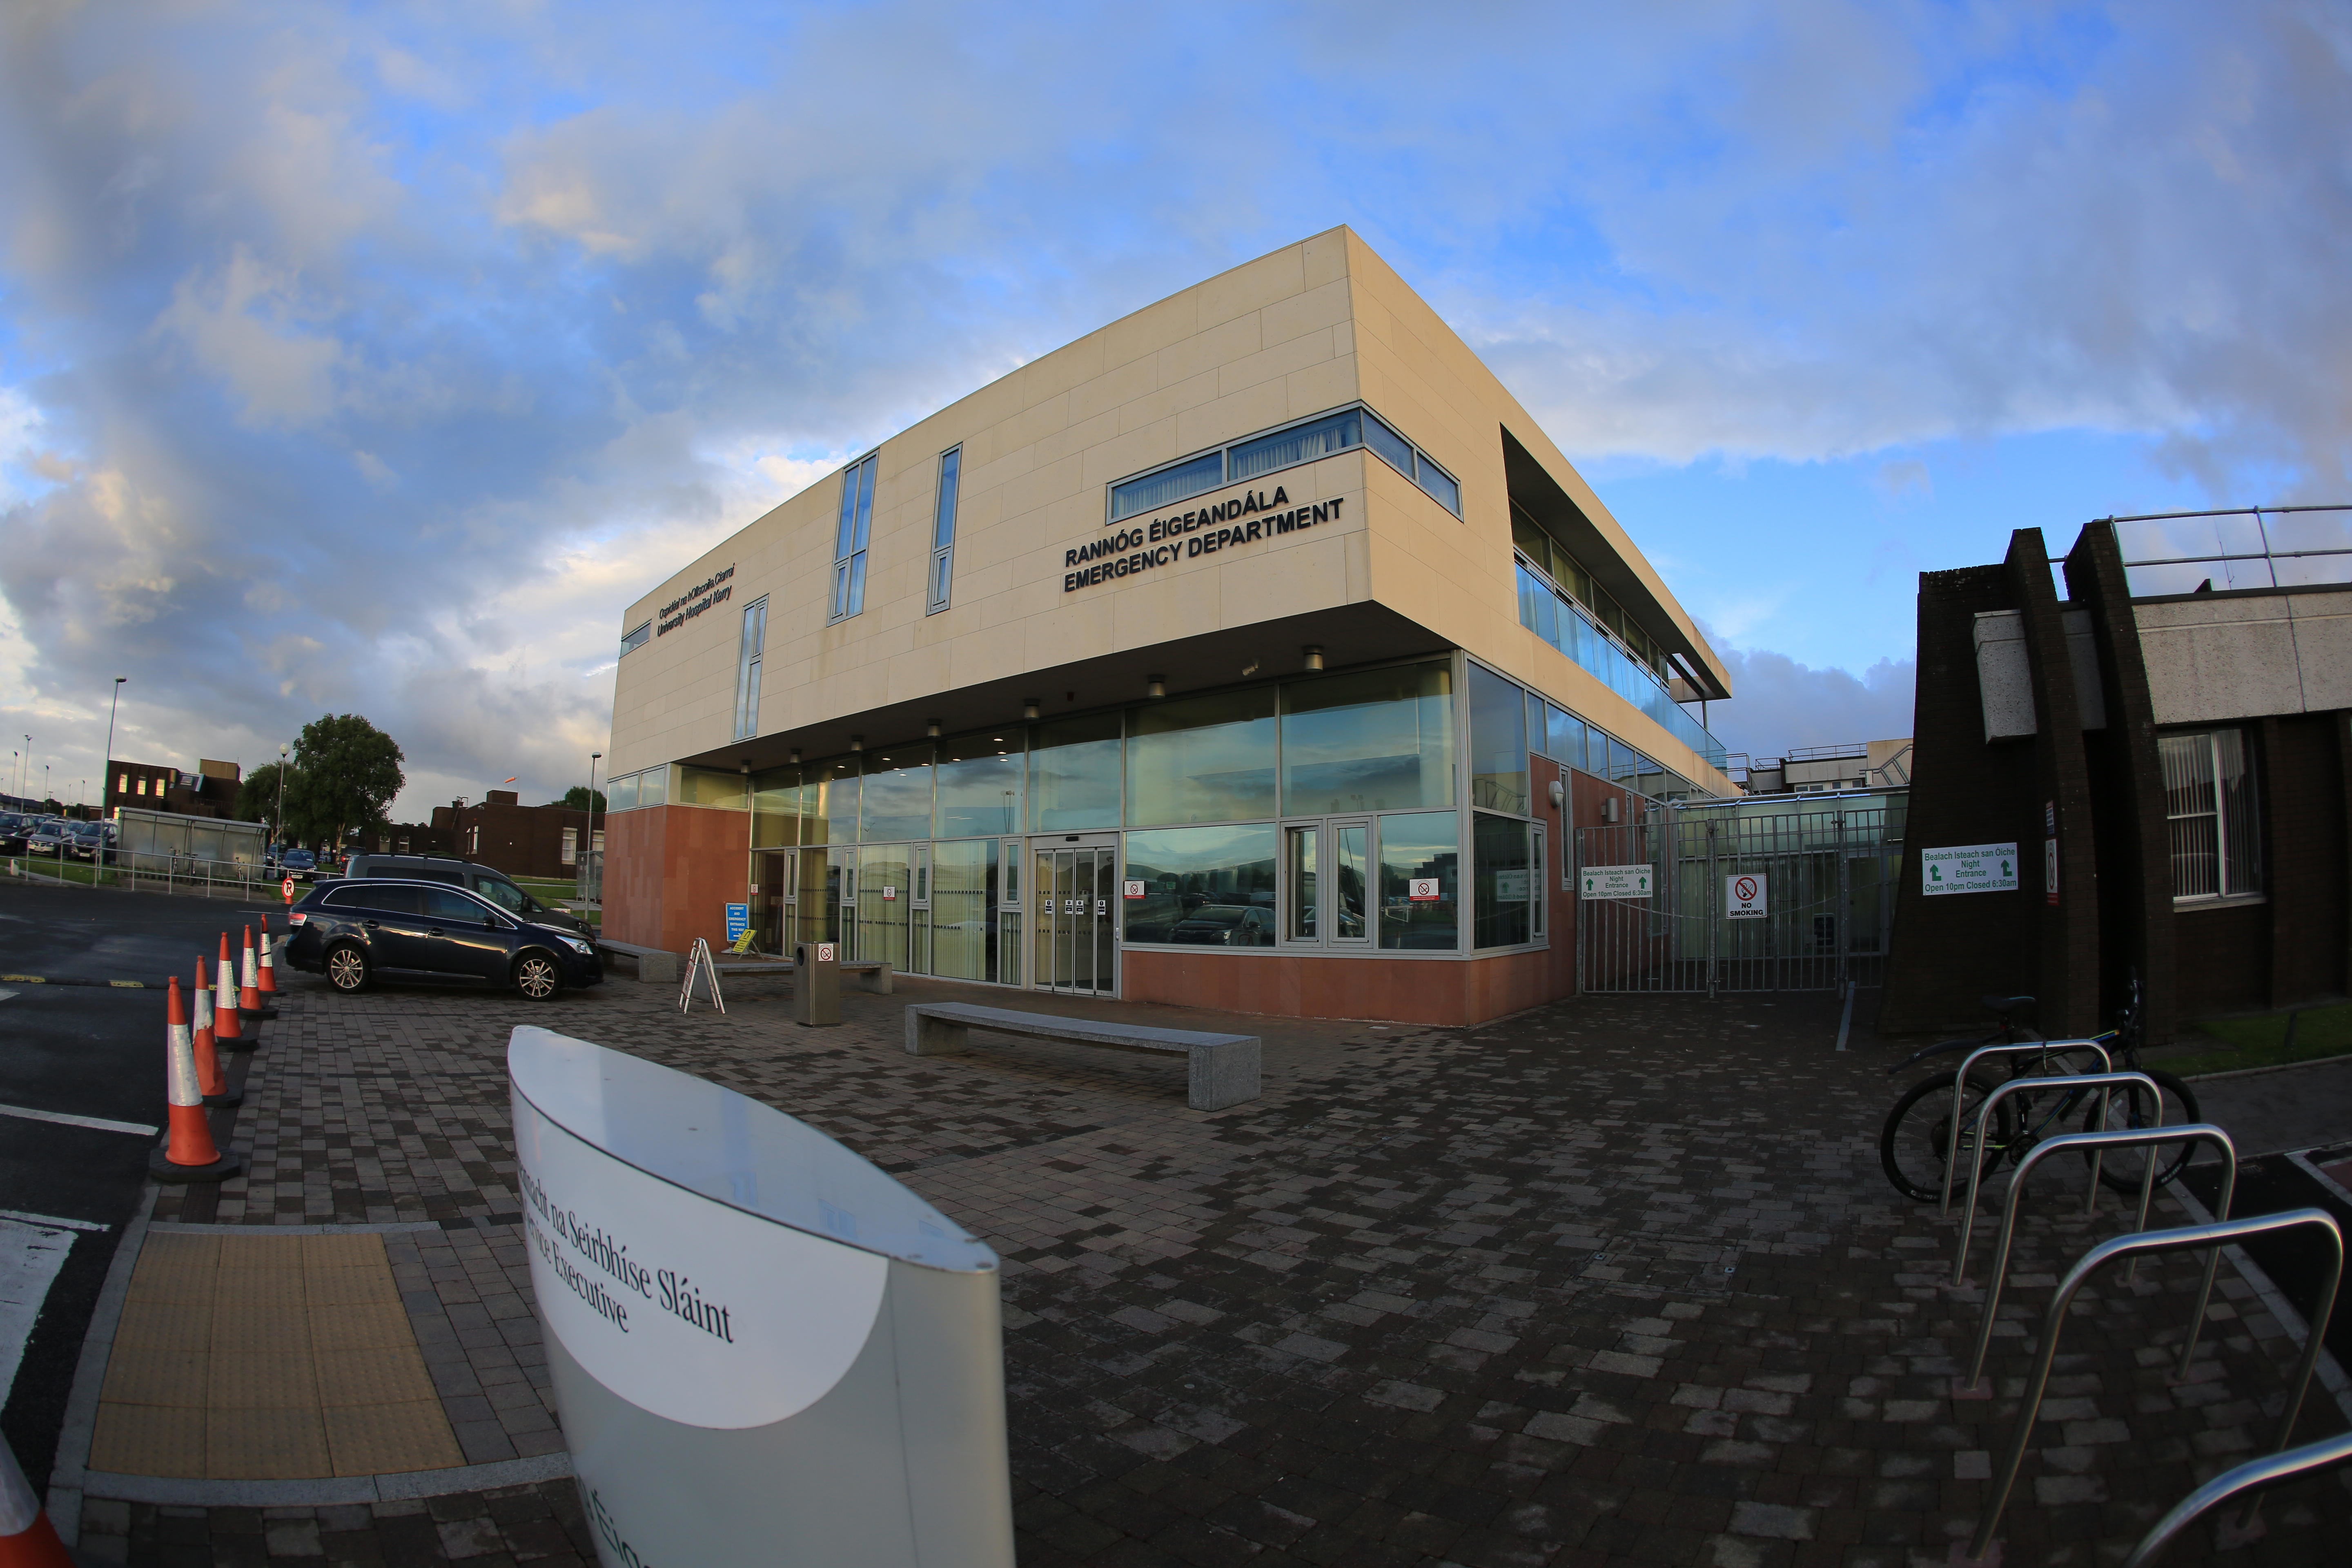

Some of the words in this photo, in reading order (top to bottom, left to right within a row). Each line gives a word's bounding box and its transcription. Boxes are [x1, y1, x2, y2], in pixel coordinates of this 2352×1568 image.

[1065, 529, 1143, 567] RANNÓG
[1149, 486, 1289, 542] ÉIGEANDÁLA
[1064, 541, 1183, 592] EMERGENCY
[1188, 497, 1344, 558] DEPARTMENT
[657, 612, 685, 637] University
[685, 593, 713, 621] Hospital
[713, 585, 732, 605] Kerry
[681, 596, 687, 606] na
[1924, 852, 1952, 861] Bealach
[1954, 850, 1979, 859] Isteach
[1995, 846, 2015, 856] Óiche
[1961, 860, 1980, 869] Night
[1924, 884, 1944, 893] Open
[1946, 882, 1964, 892] 10pm
[1966, 880, 1990, 889] Closed
[1992, 879, 2017, 887] 6:30am
[1956, 870, 1987, 878] Entrance
[551, 1203, 568, 1239] na
[568, 1210, 652, 1299] Seirbhíse
[657, 1268, 734, 1344] Sláint
[552, 1239, 629, 1333] Executive
